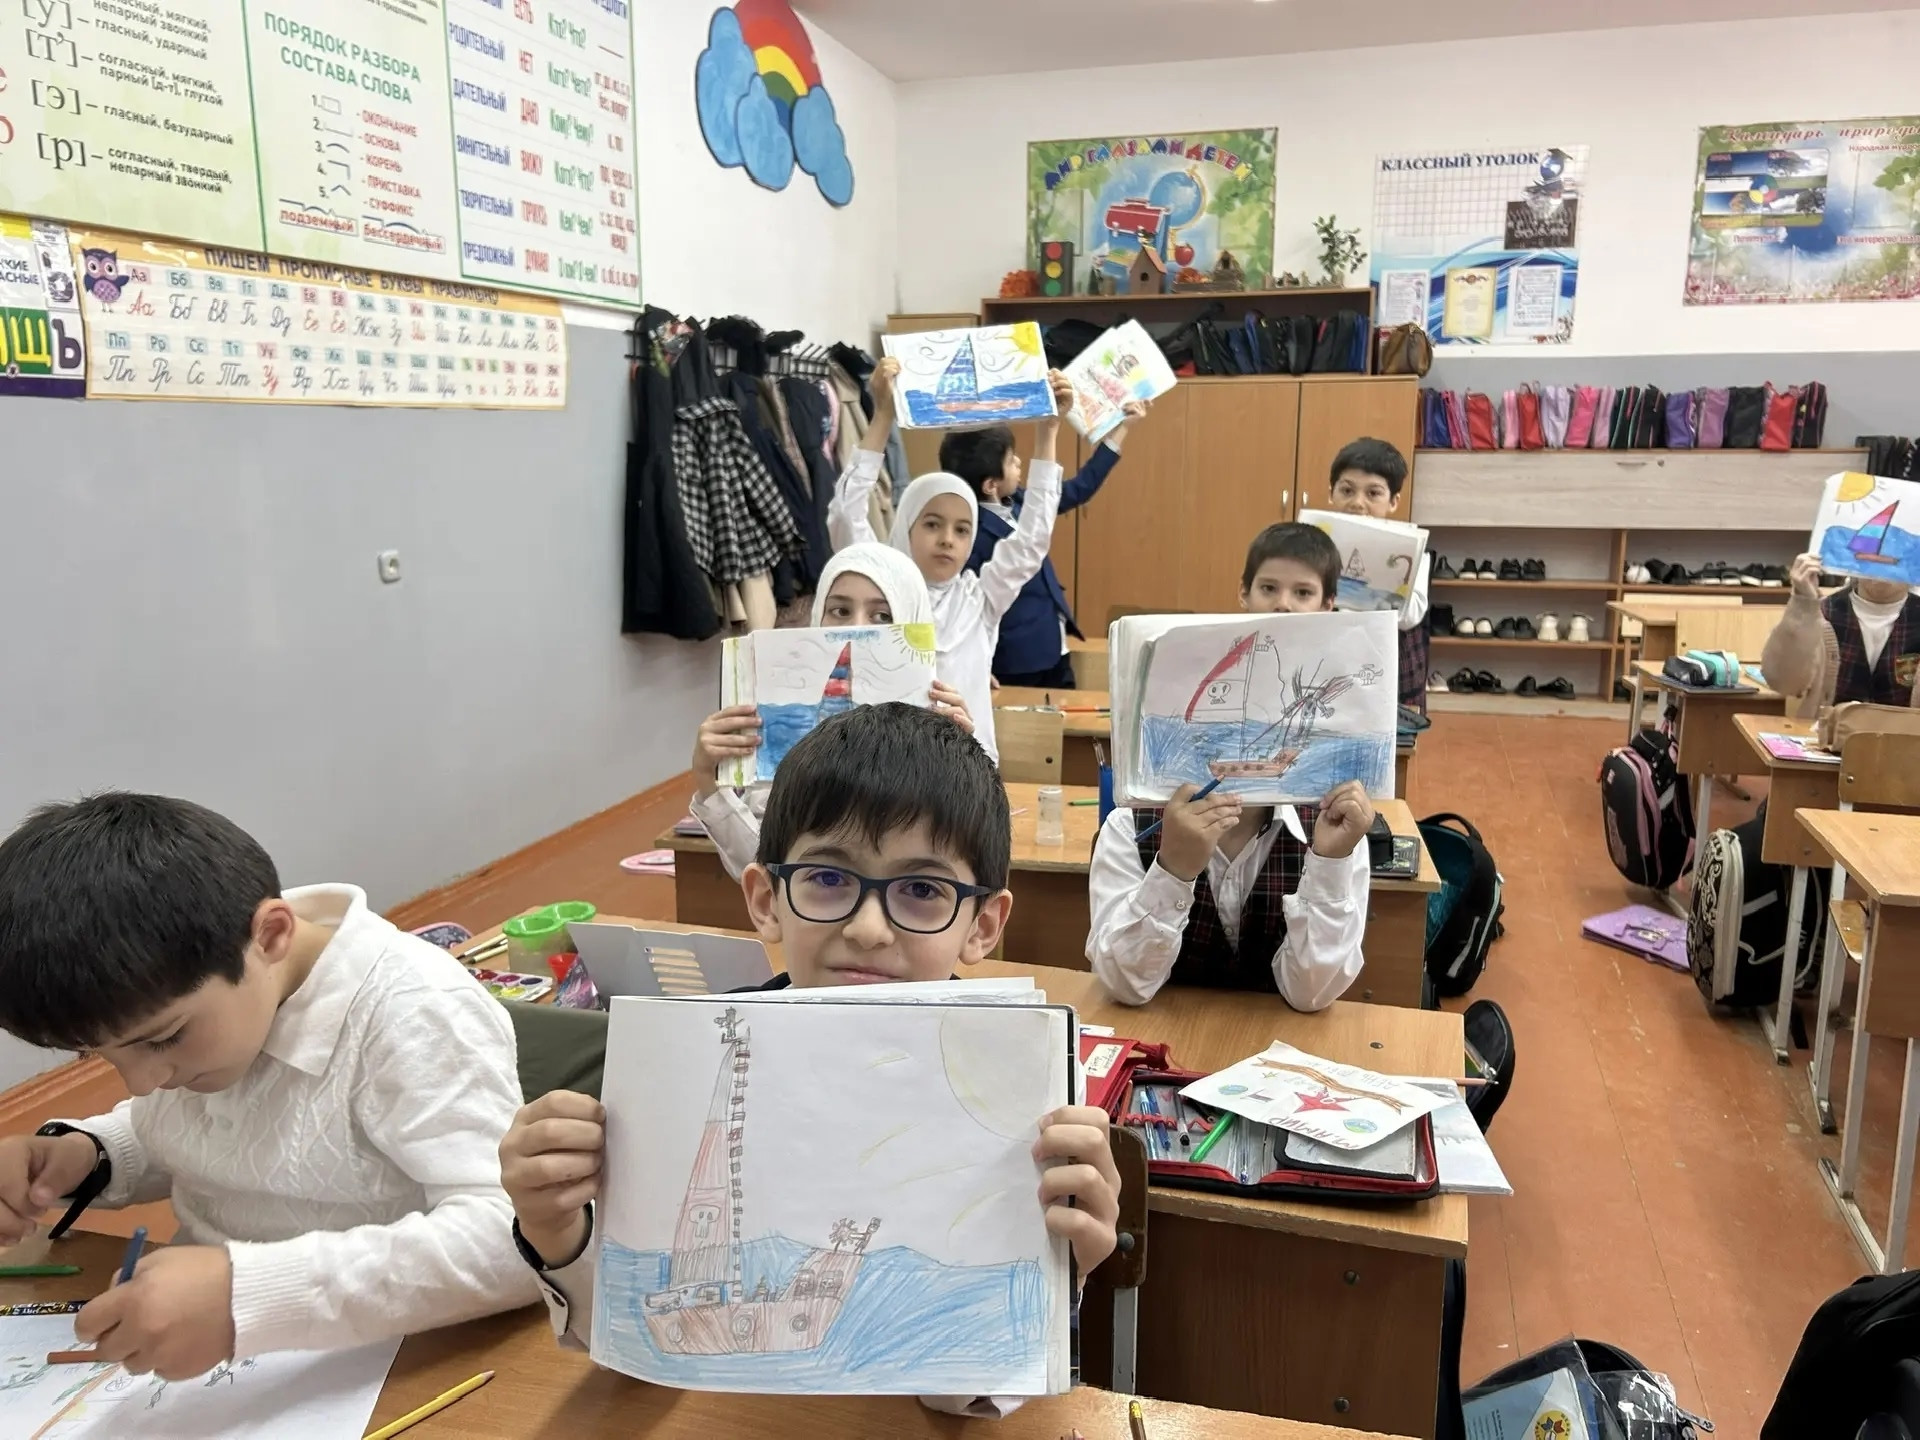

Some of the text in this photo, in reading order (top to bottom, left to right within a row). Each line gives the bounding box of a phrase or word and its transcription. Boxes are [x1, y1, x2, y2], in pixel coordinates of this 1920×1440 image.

[94, 17, 154, 45] гласный,
[155, 36, 208, 61] ударный
[159, 20, 209, 43] звонкий
[264, 11, 421, 83] ПОРЯДОК РАЗБОРА
[449, 21, 506, 61] РОДИТЕЛЬНЫЙ
[518, 49, 534, 74] НЕТ
[97, 50, 170, 81] согласный,
[171, 72, 218, 94] мягкий,
[99, 65, 150, 88] парный
[183, 84, 225, 107] глухой
[280, 46, 413, 105] СОСТАВА СЛОВА
[452, 77, 508, 113] ДАТЕЛЬНЫЙ
[103, 103, 162, 130] гласный,
[163, 118, 234, 146] безударный
[361, 109, 418, 138] ОКОНЧАНИЕ
[107, 146, 178, 171] согласный,
[363, 132, 402, 153] ОСНОВА
[456, 134, 511, 167] ВИНИТЕЛЬНЫЙ
[109, 161, 224, 194] непарный звонкий
[365, 154, 403, 173] КОРЕНЬ
[1186, 143, 1255, 182] ДЕТЕЙ
[1381, 152, 1540, 172] КЛАССНЫЙ УГОЛОК
[367, 175, 422, 199] ПРИСТАВКА
[459, 188, 514, 218] ТВОРИТЕЛЬНЫЙ
[369, 197, 415, 218] СУФФИКС
[279, 209, 443, 250] подземный бессердечный
[463, 240, 515, 267] ПРЕДЛОЖНЫЙ
[130, 267, 147, 282] Аа
[170, 271, 188, 287] Бб
[203, 247, 270, 273] ПИШЕМ
[379, 272, 424, 294] БУКВЫ
[430, 280, 499, 306] ПРАВИЛЬНО
[126, 288, 155, 317] Аа
[169, 293, 198, 320] Бб
[207, 298, 229, 324] Вв
[240, 300, 258, 327] Гг
[270, 305, 292, 338] Дд
[108, 332, 127, 348] Пп
[150, 335, 166, 353] Рр
[189, 338, 205, 353] Сс
[225, 340, 239, 355] Тт
[103, 354, 136, 381] Пп
[148, 357, 172, 392] Рр
[187, 360, 205, 385] Сс
[216, 361, 251, 387] Тт
[261, 365, 279, 396] Уу
[291, 365, 313, 396] Фф
[321, 366, 351, 391] Хх
